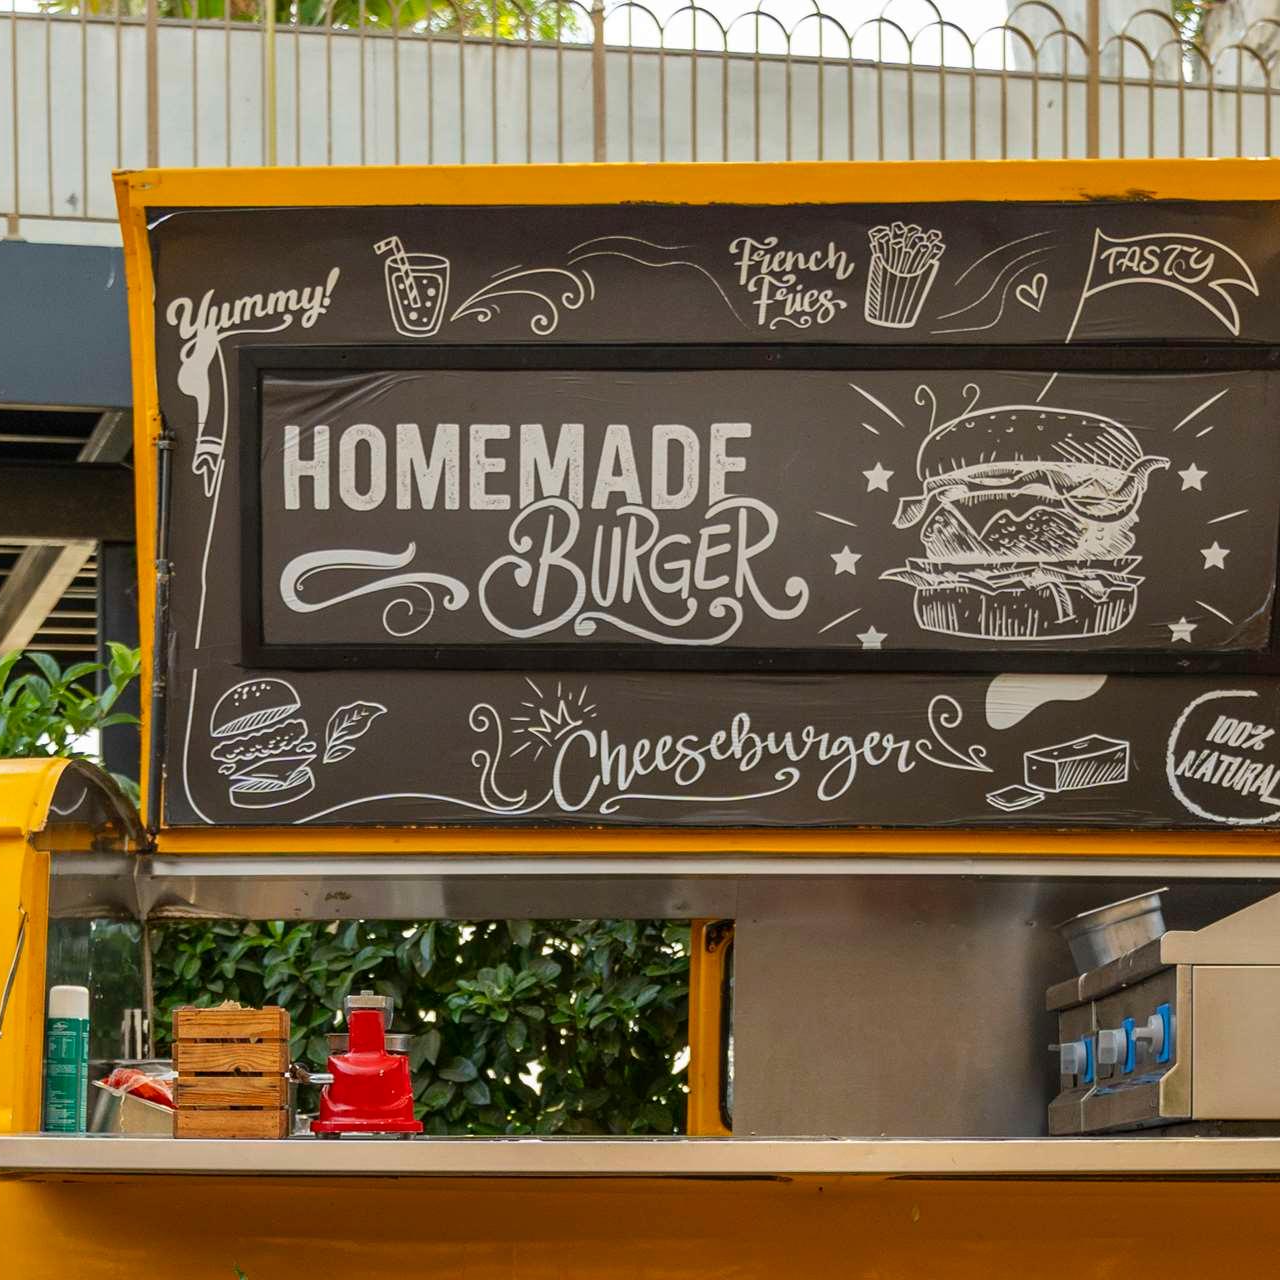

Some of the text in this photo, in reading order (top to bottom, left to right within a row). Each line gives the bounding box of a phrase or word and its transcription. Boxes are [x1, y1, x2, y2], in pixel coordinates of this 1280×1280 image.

[729, 236, 855, 286] French
[1101, 247, 1214, 284] TASTY
[166, 267, 341, 358] Yummy!
[749, 274, 847, 330] Fries
[283, 422, 752, 511] HOMEMADE
[477, 496, 810, 645] BURGER
[552, 712, 916, 813] Cheeseburger
[1205, 714, 1276, 751] 100%
